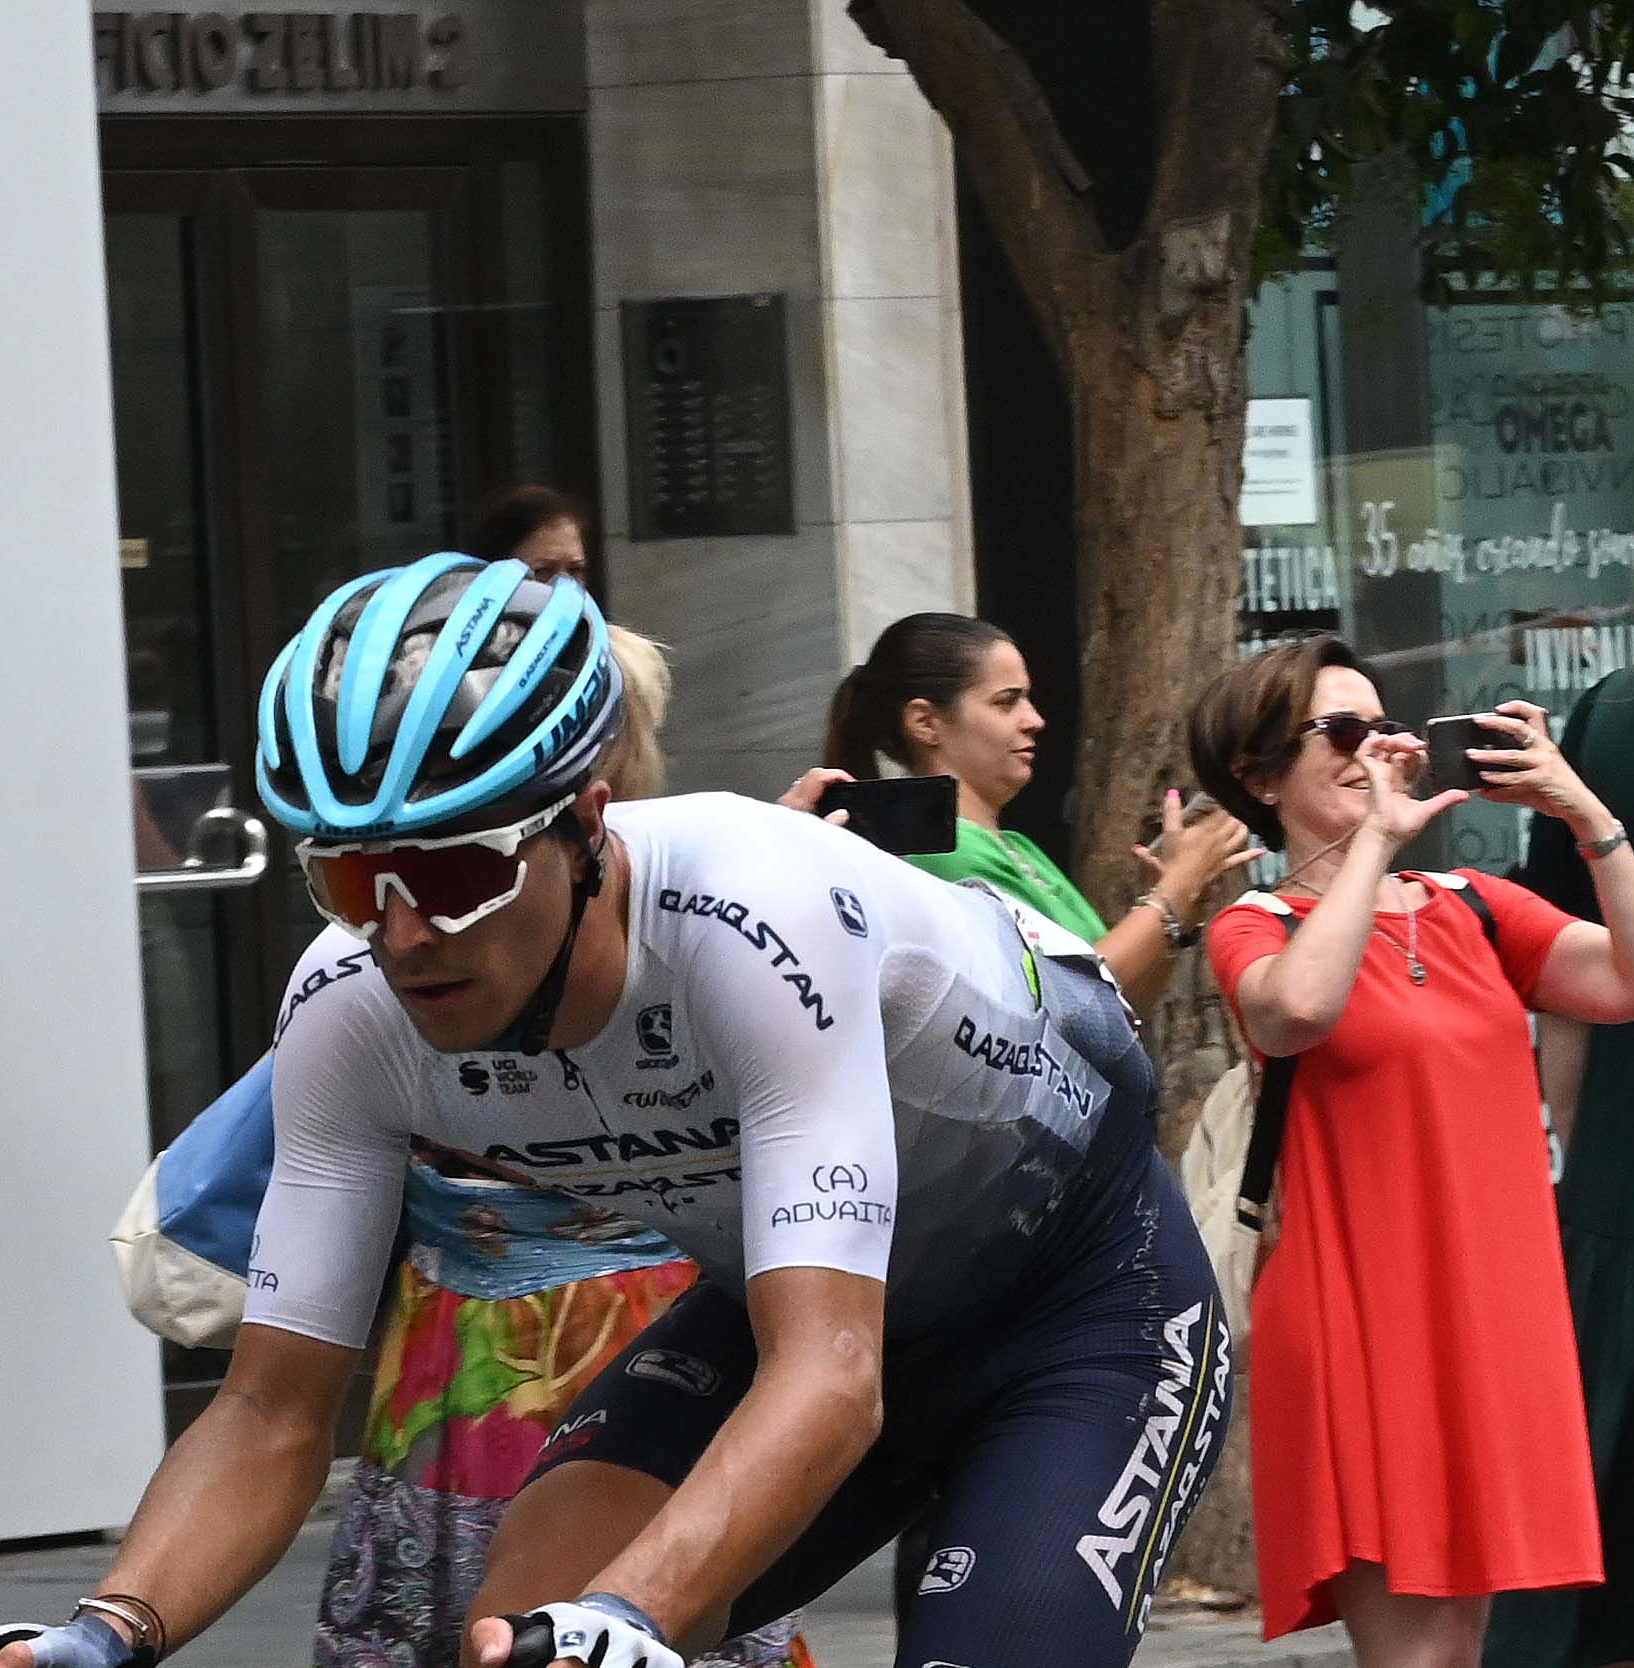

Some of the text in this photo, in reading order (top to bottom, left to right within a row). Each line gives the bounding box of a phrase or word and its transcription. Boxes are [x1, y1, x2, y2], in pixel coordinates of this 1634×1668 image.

[238, 13, 417, 93] ZELIM
[1363, 501, 1398, 576] 35
[455, 597, 495, 657] ASTANA
[659, 889, 834, 1031] QAZAQSTAN
[492, 1058, 518, 1070] UCI
[954, 1015, 1093, 1118] QAZAQSTAN
[771, 1200, 894, 1228] ADVAITA
[1075, 1301, 1203, 1611] ASTANA
